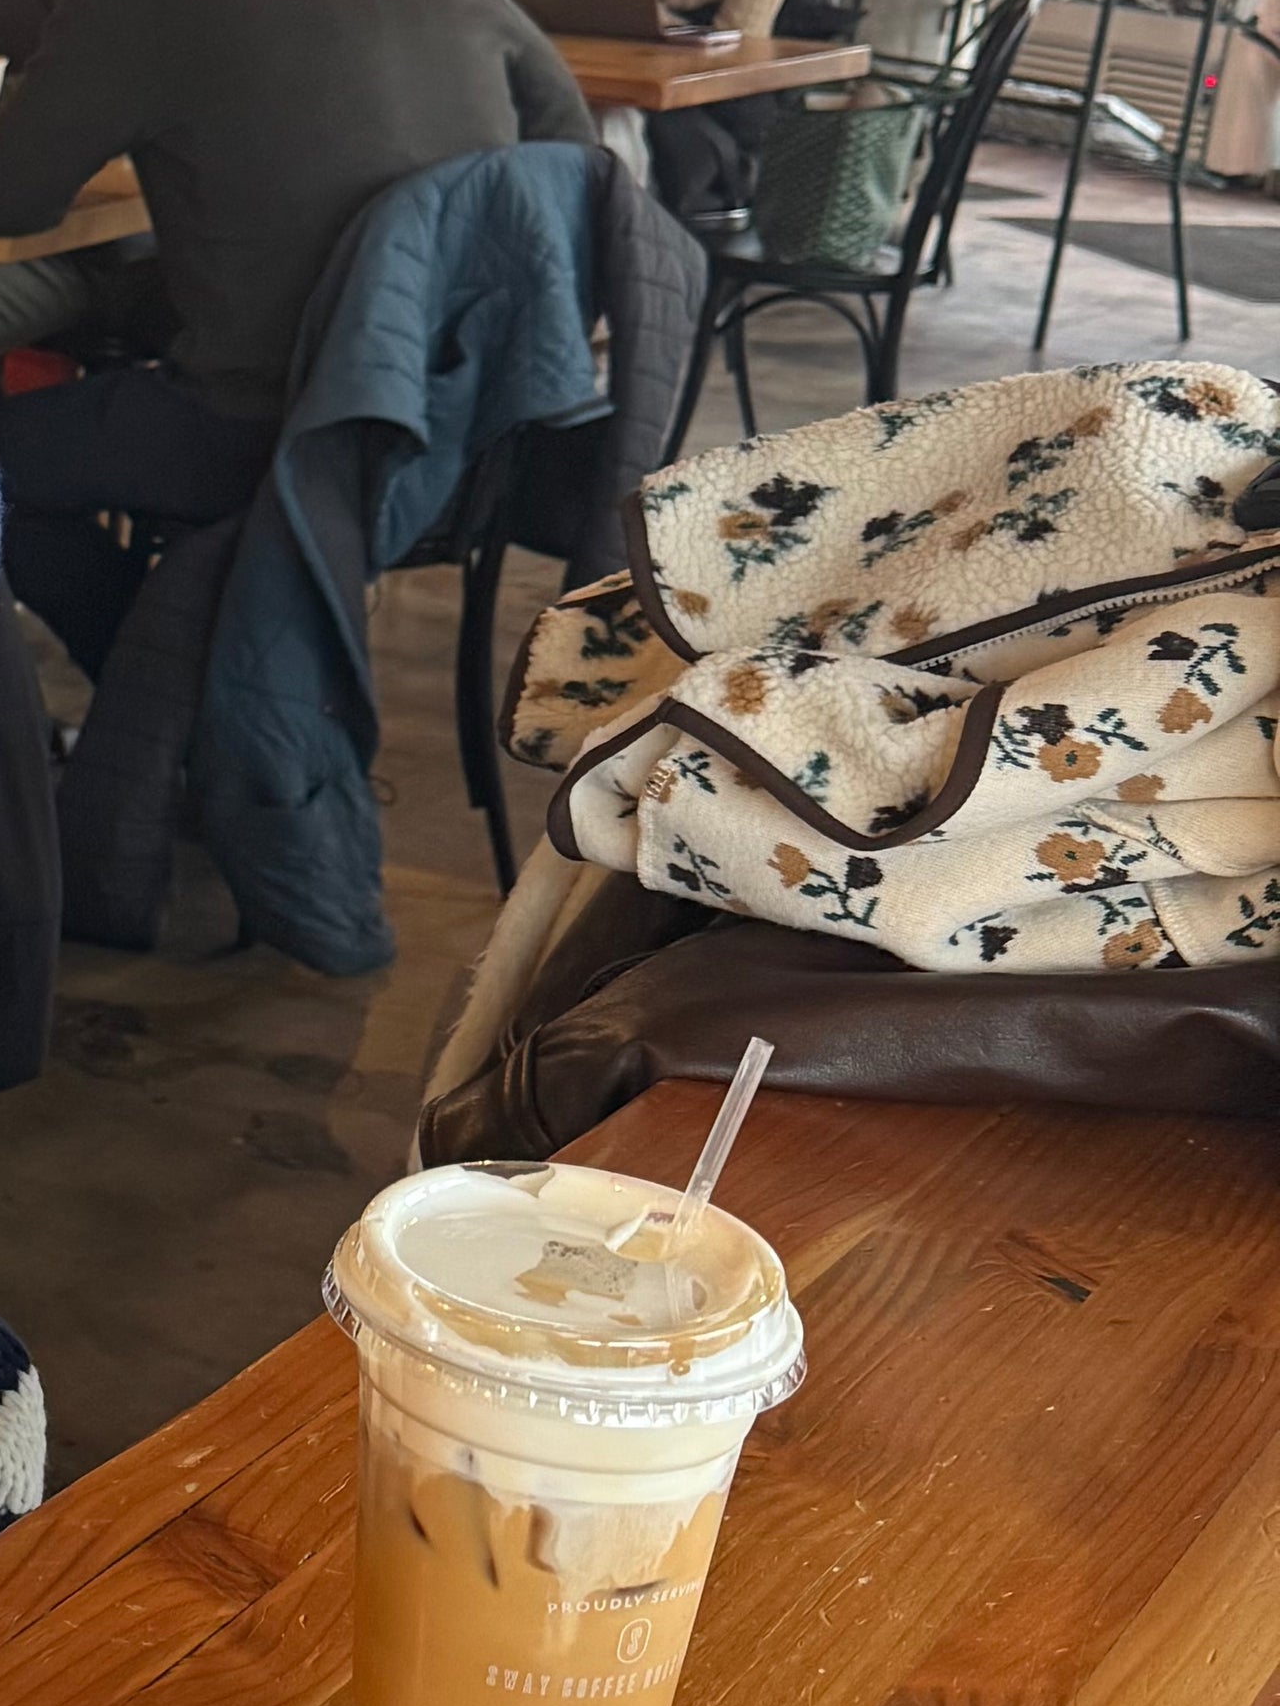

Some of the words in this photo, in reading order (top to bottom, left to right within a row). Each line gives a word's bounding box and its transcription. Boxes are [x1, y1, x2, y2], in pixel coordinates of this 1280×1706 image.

[547, 1595, 644, 1613] PROUDLY
[486, 1664, 550, 1697] SWAY
[561, 1672, 637, 1699] COFFEE
